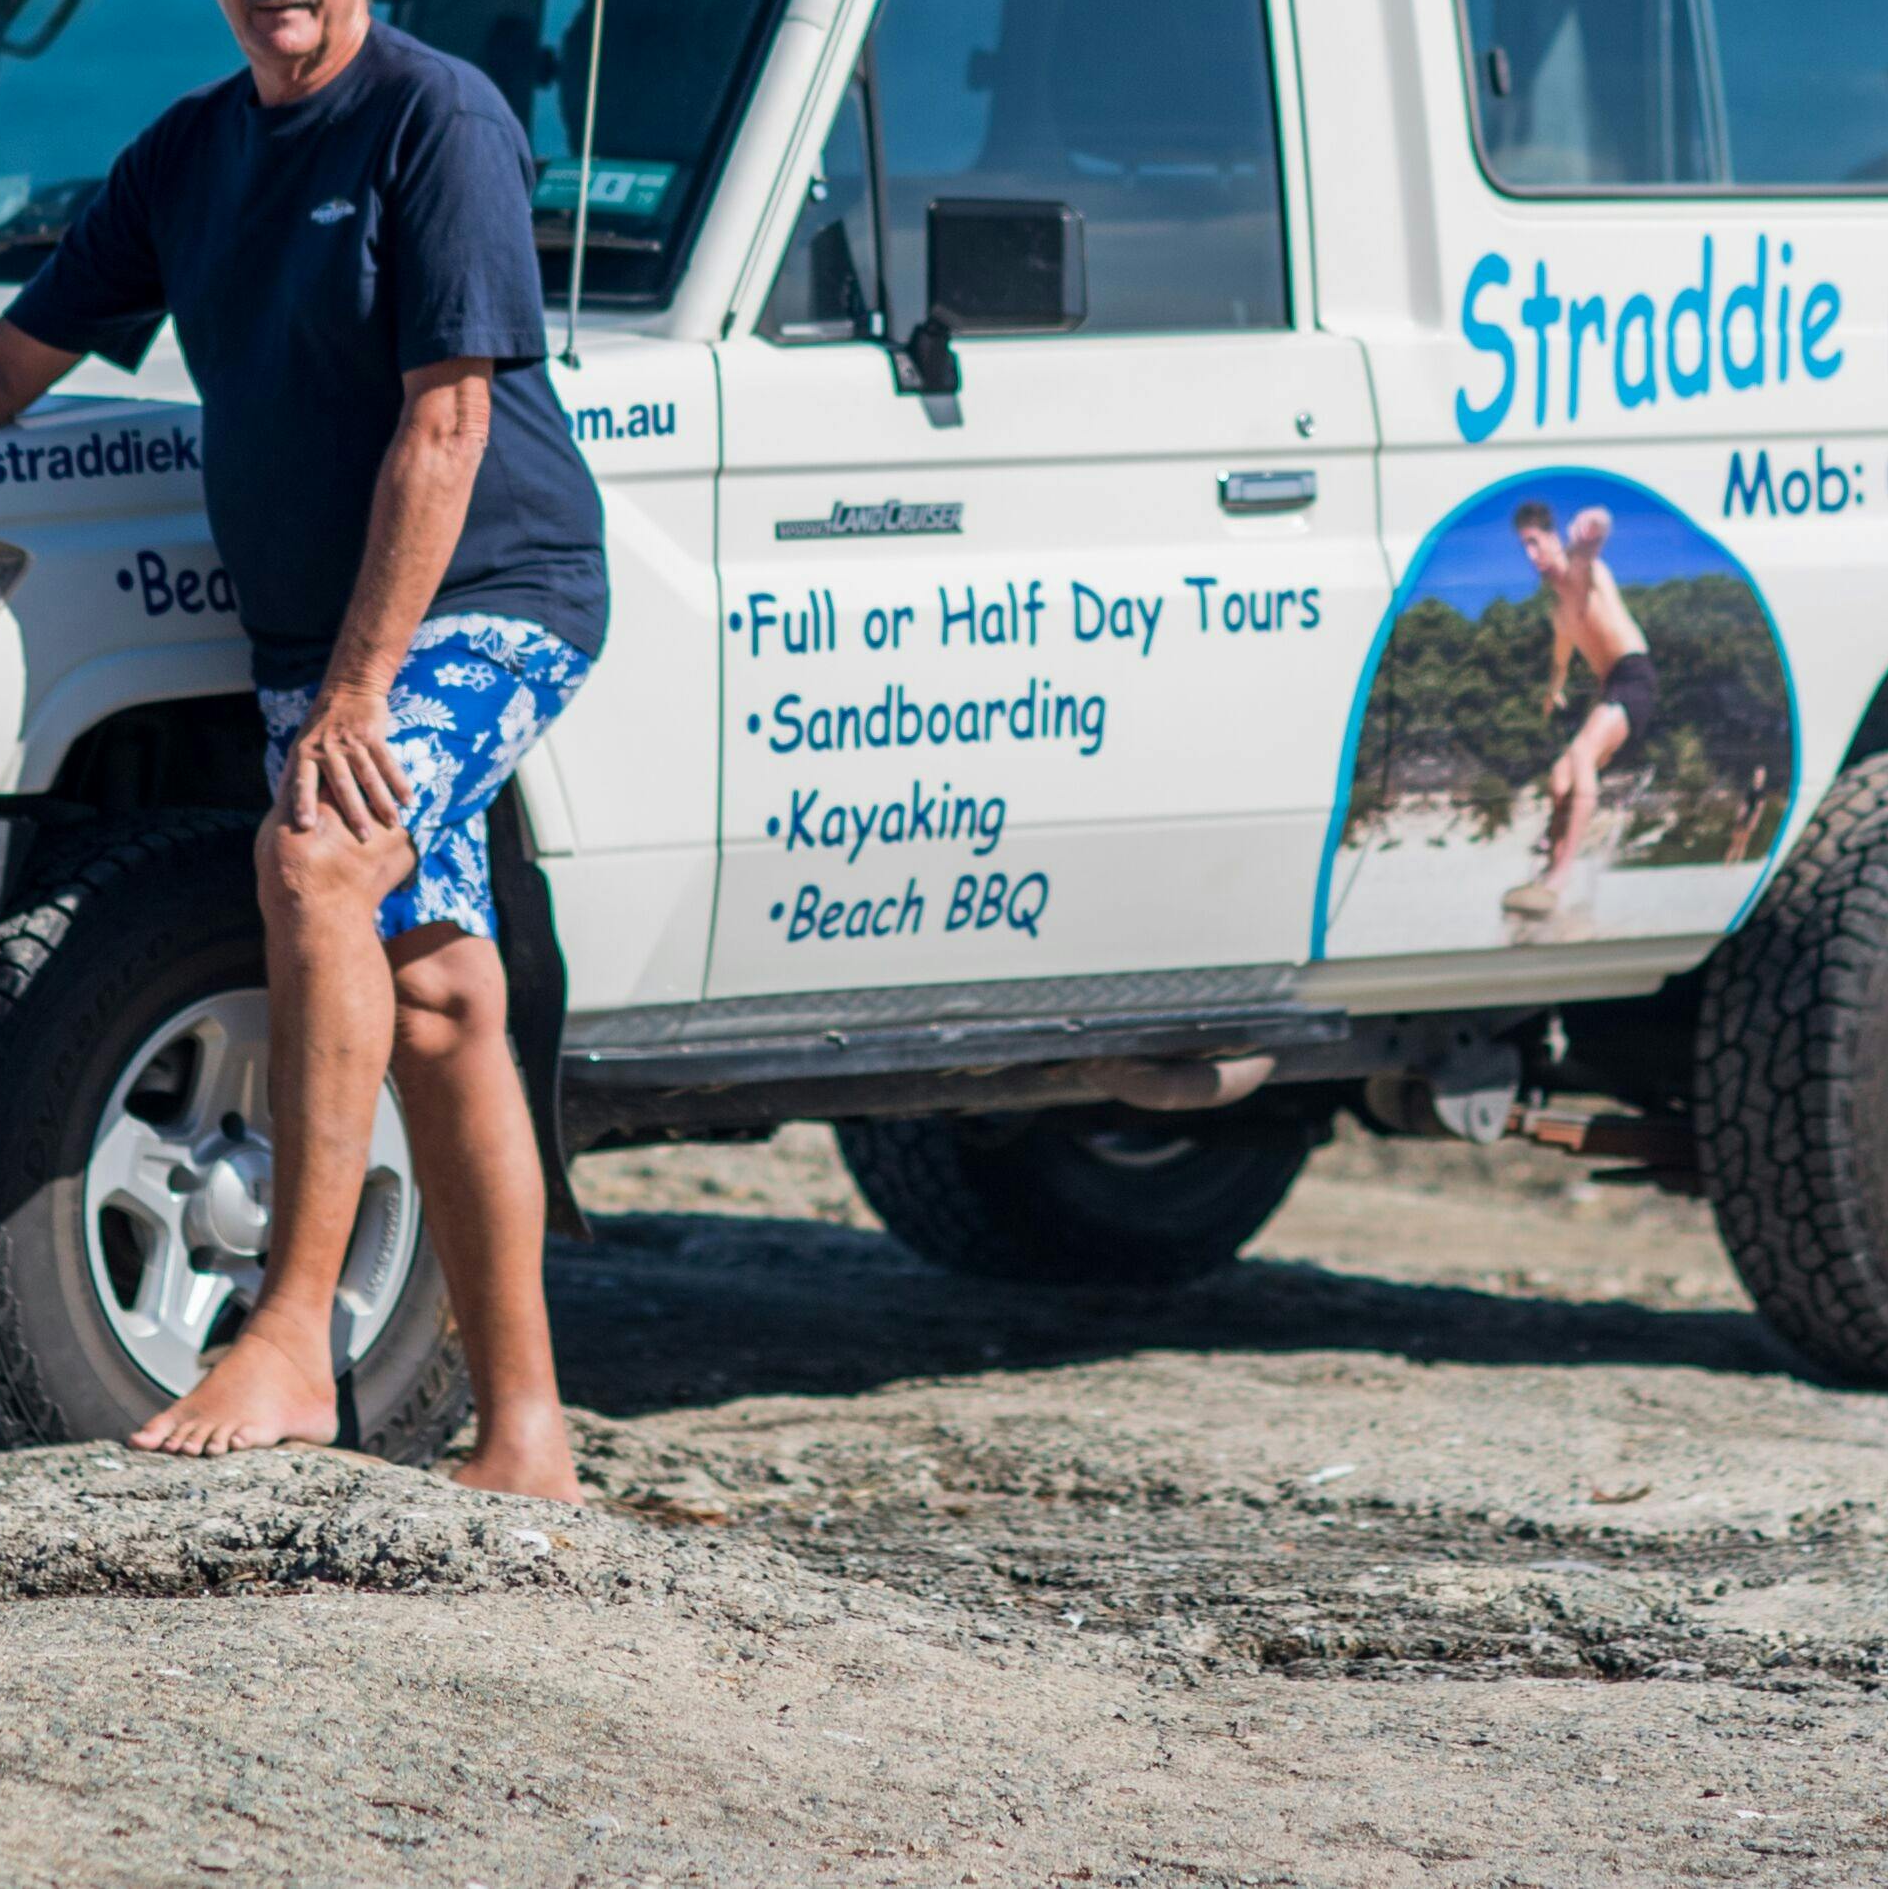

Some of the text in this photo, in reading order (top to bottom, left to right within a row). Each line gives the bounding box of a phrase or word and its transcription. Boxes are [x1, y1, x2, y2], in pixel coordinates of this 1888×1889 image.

[1454, 233, 1845, 444] Straddie
[1722, 448, 1866, 516] Mob:
[748, 576, 1322, 657] Full or Half Day Tours
[768, 677, 1107, 756] Sandboarding
[786, 779, 1007, 865] Kayaking
[786, 872, 1051, 943] Beach BBQ
